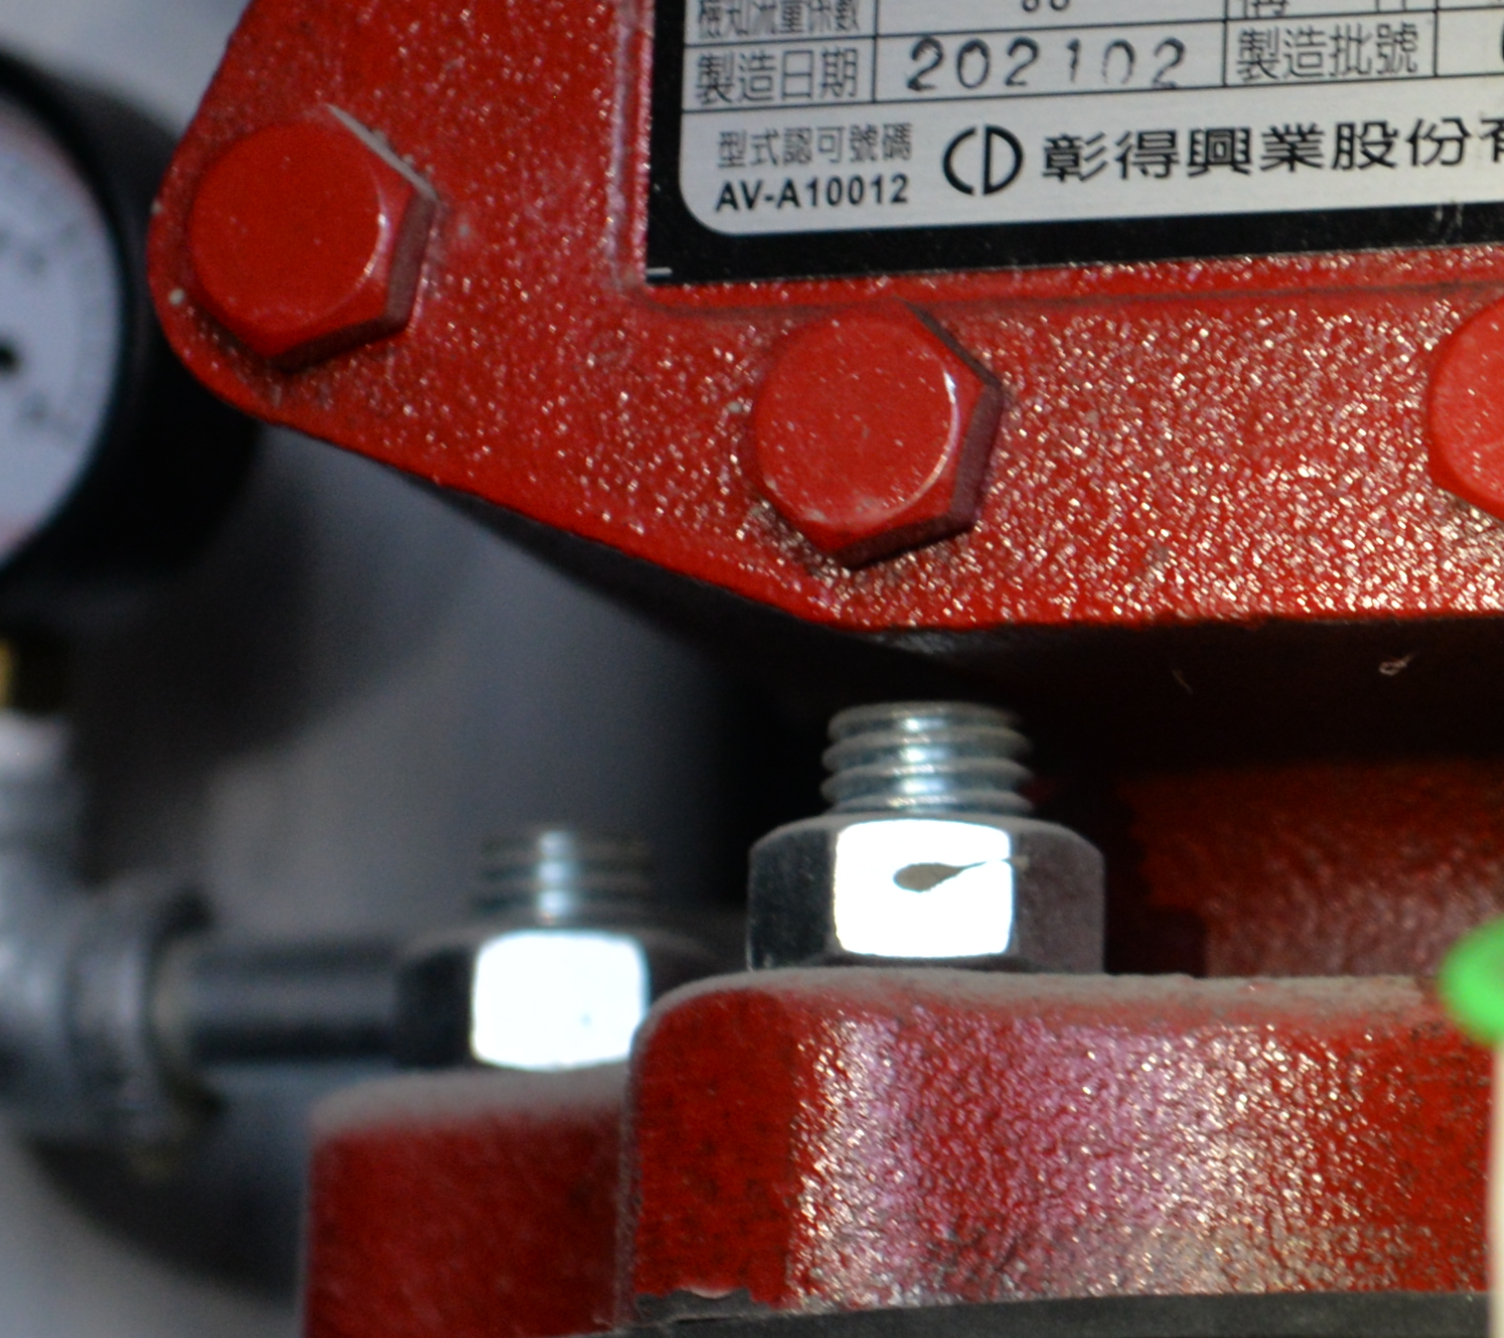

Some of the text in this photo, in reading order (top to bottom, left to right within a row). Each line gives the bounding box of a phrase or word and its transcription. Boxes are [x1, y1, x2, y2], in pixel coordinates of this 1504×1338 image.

[696, 45, 859, 106] 製造日期
[906, 35, 1187, 93] 202102
[1236, 22, 1420, 83] 製造批號
[717, 122, 914, 169] 型式認可號碼
[715, 173, 910, 213] AV-A10012
